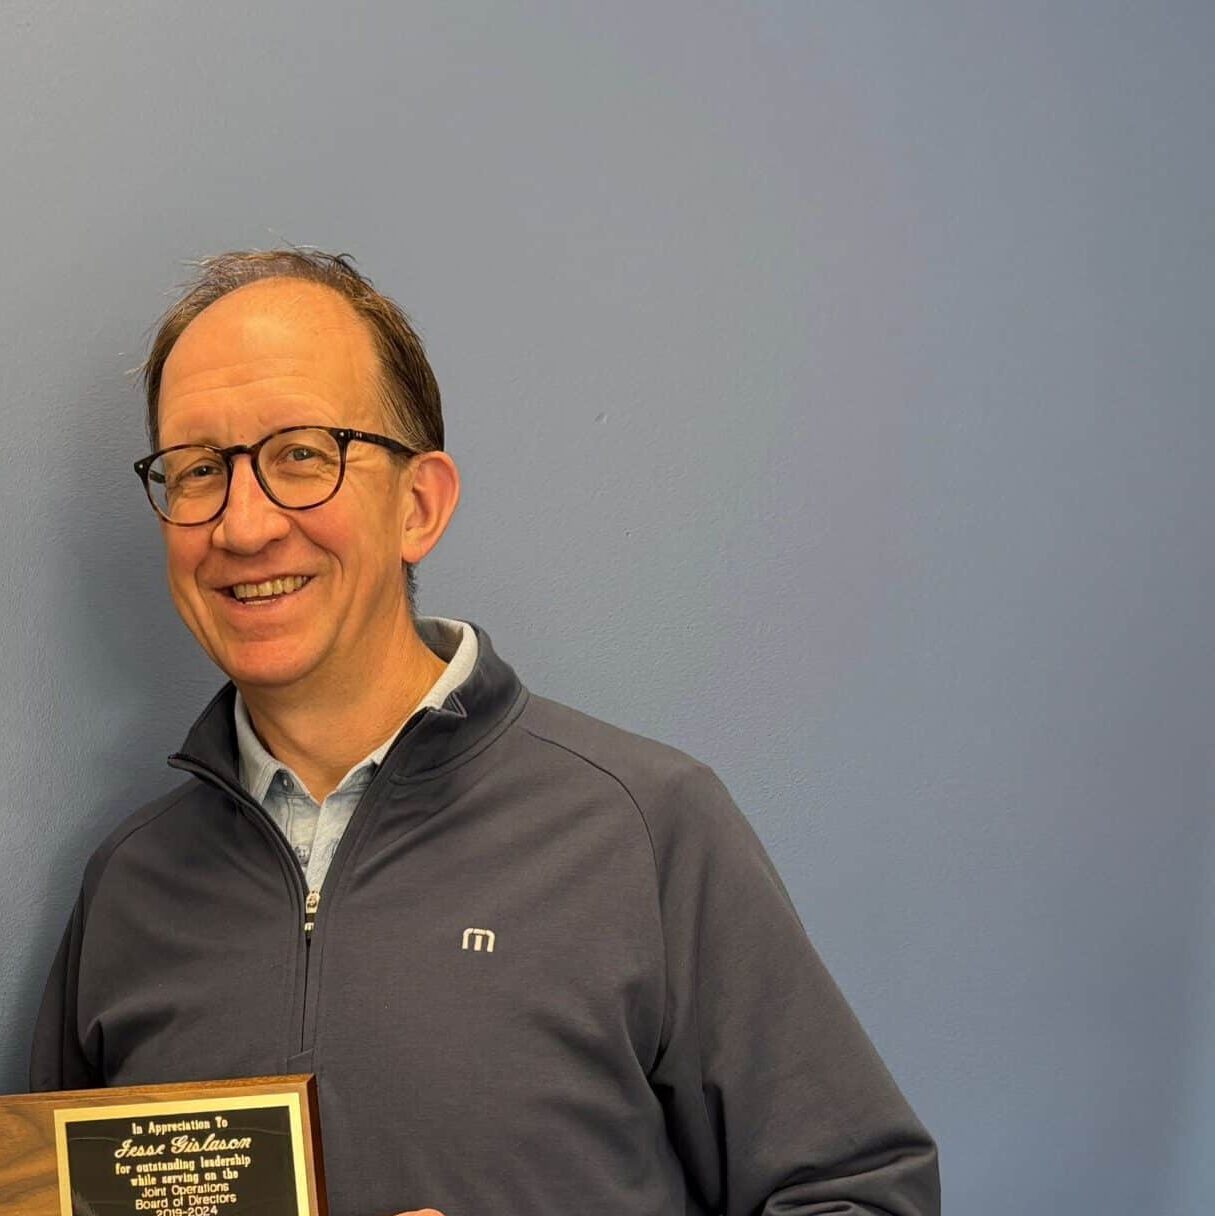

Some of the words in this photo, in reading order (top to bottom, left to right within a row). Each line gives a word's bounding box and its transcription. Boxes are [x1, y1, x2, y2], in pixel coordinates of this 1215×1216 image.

[132, 1123, 143, 1135] In
[148, 1120, 210, 1135] Appreciation
[215, 1116, 228, 1128] To
[114, 1139, 166, 1158] Jesse
[171, 1133, 252, 1154] Gislason
[115, 1163, 131, 1175] for
[136, 1158, 195, 1172] outstanding
[201, 1154, 251, 1168] leadership
[131, 1176, 156, 1186] while
[162, 1172, 199, 1184] serving
[205, 1172, 217, 1180] on
[223, 1168, 239, 1179] the
[142, 1187, 167, 1198] Joint
[171, 1183, 229, 1198] Operations
[136, 1198, 168, 1210] Board
[173, 1196, 184, 1207] of
[189, 1193, 237, 1206] Directors
